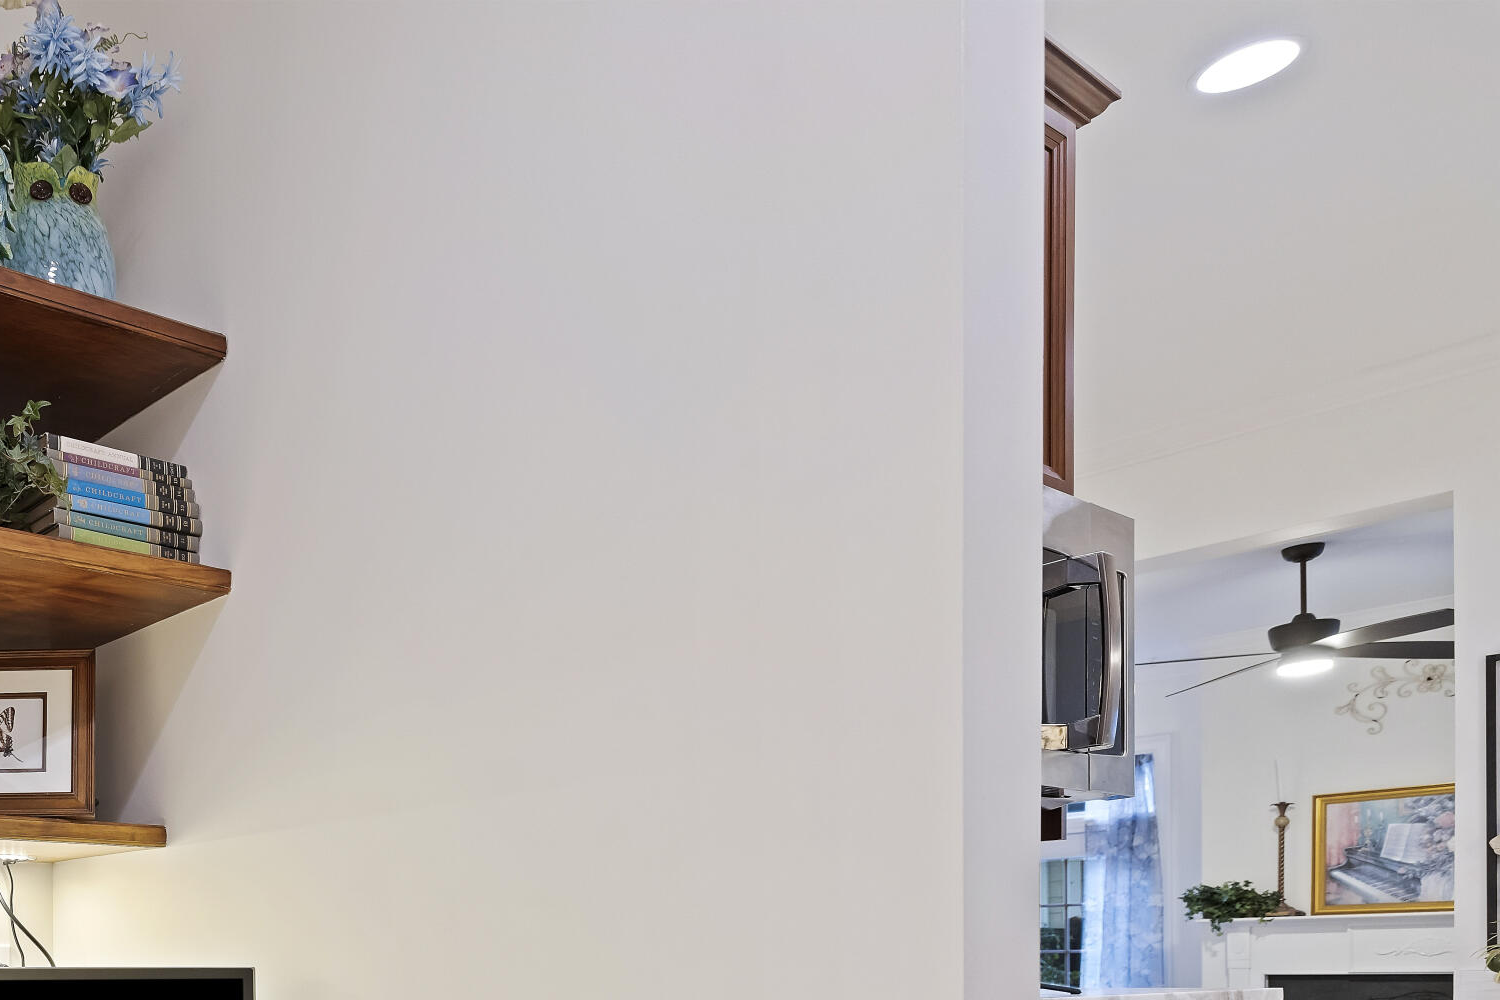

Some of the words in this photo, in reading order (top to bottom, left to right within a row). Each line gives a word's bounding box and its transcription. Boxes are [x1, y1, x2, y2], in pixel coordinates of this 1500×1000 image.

[81, 457, 136, 475] CHILDCRAFT
[85, 470, 138, 489] CHILD
[85, 487, 142, 503] CHILDCRAFT
[90, 501, 147, 519] CHILDCRAF
[88, 520, 143, 536] CHILDCRAFT
